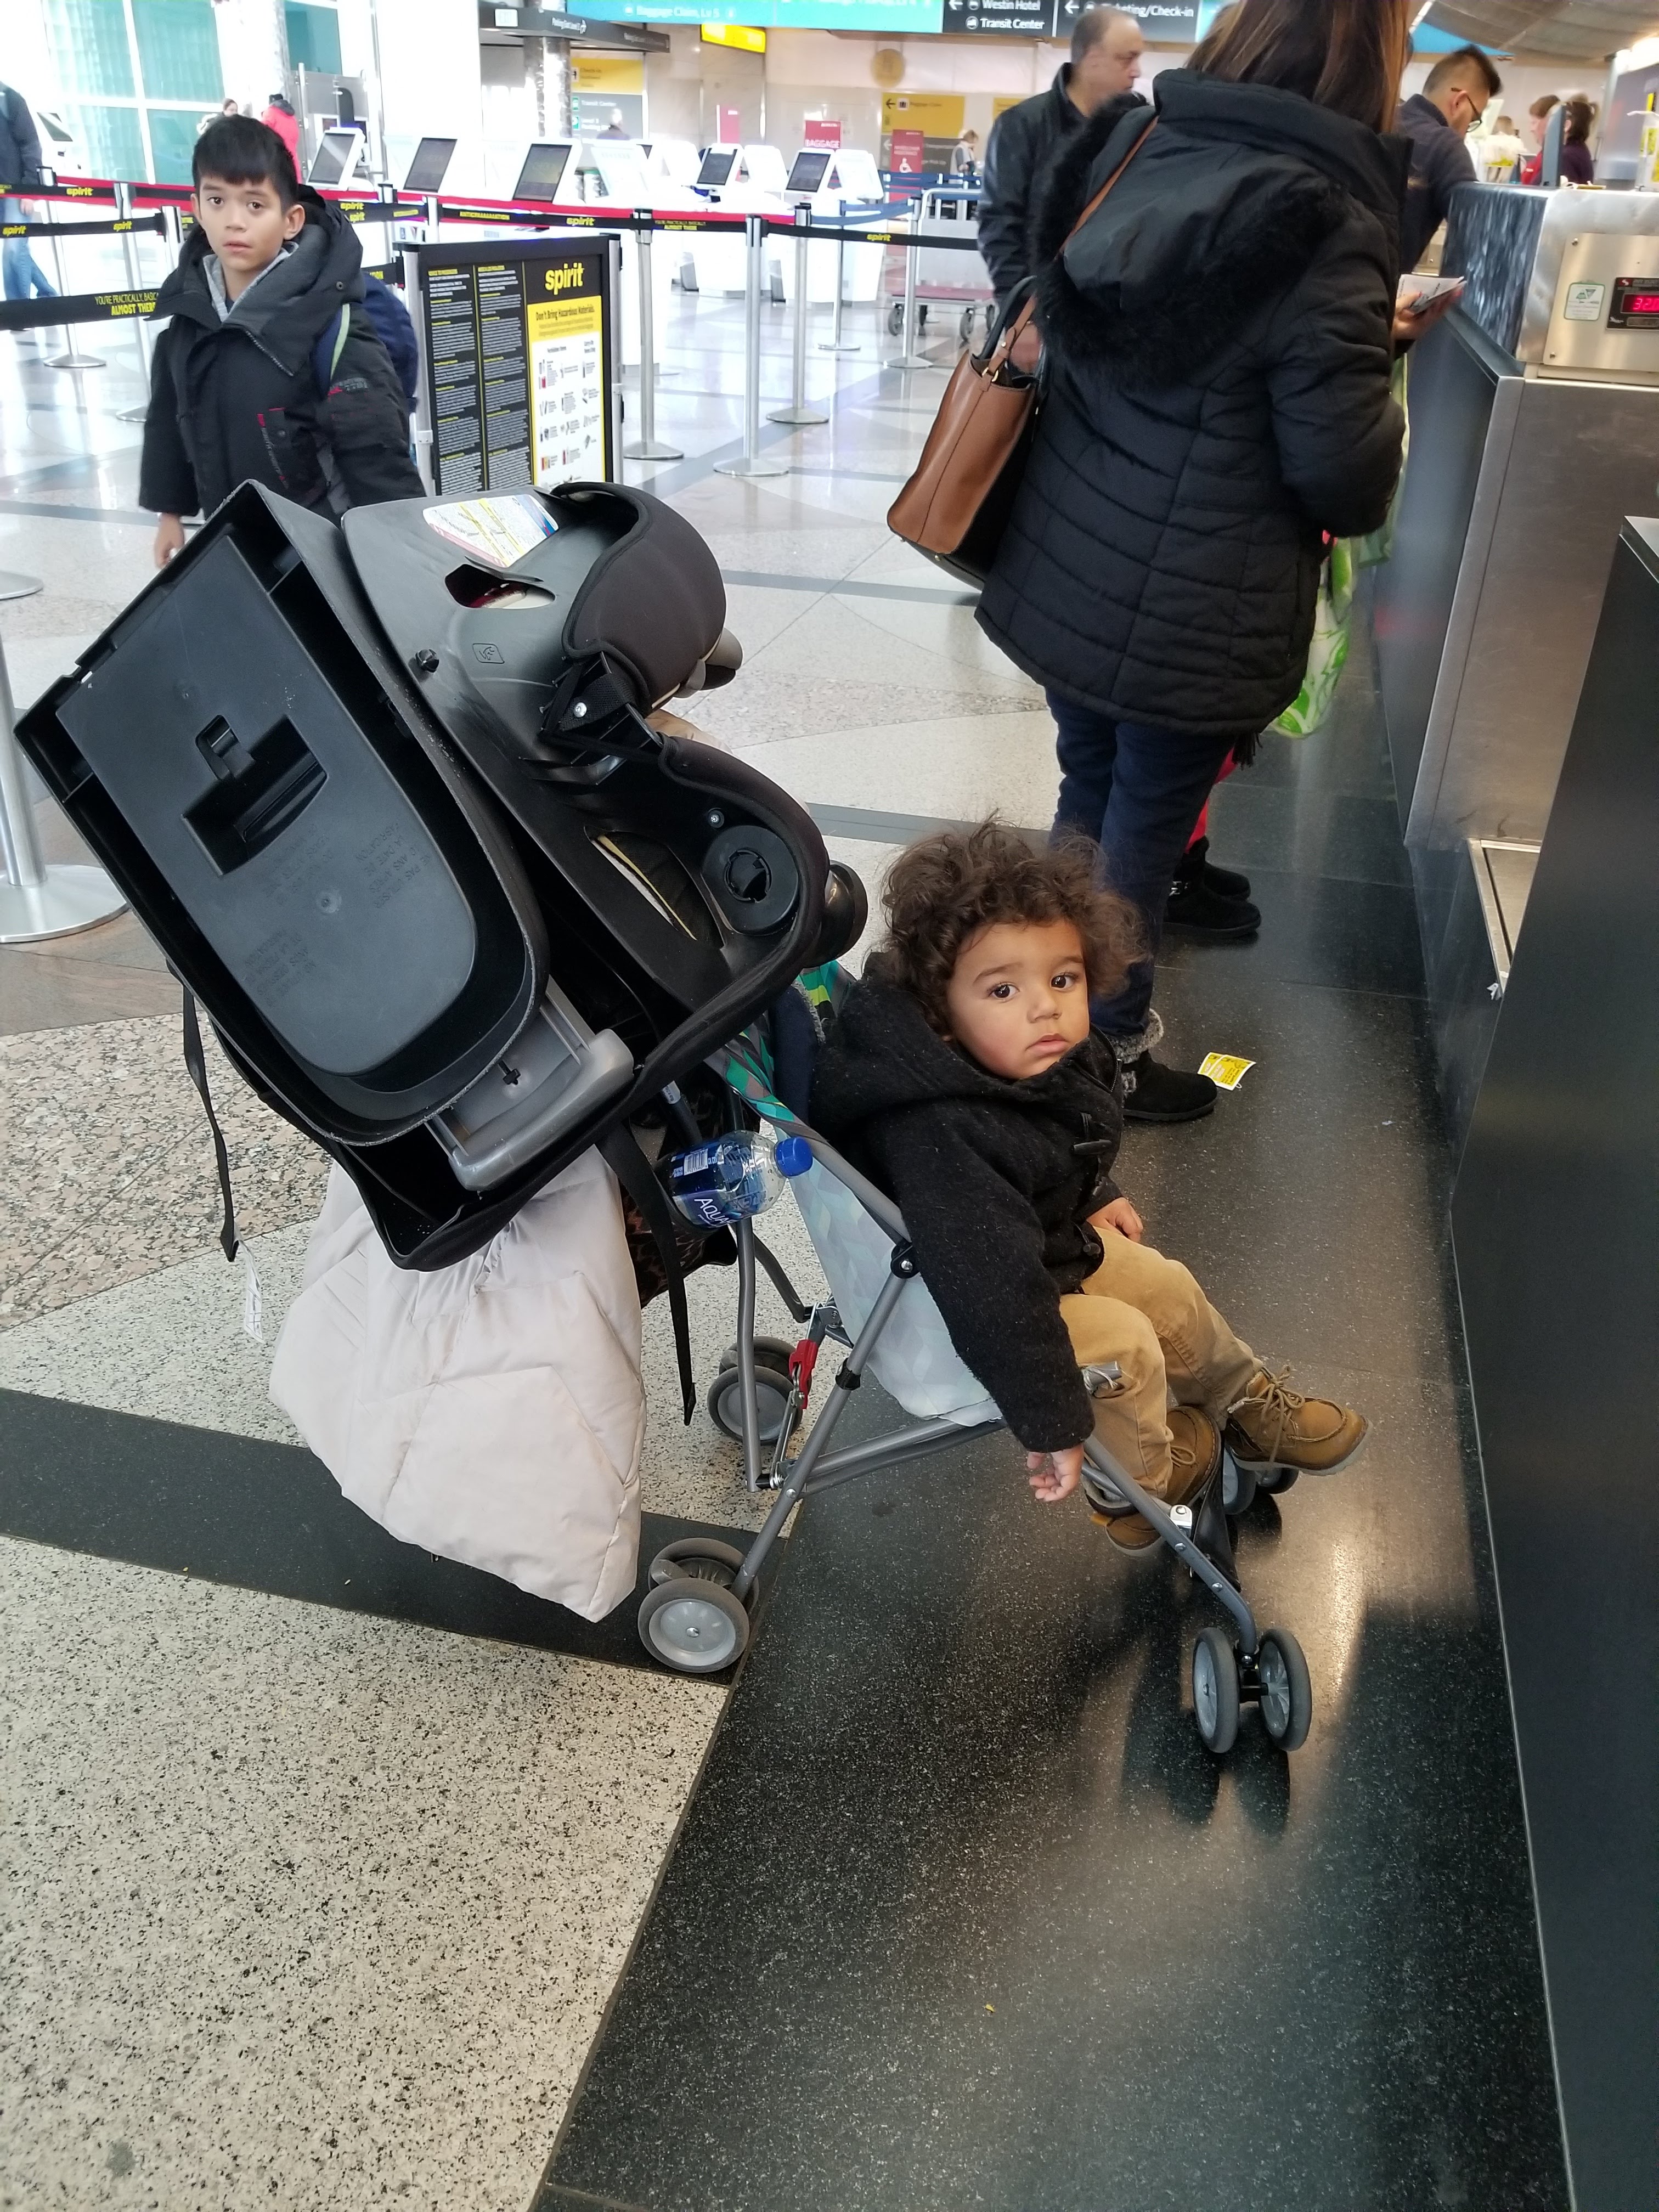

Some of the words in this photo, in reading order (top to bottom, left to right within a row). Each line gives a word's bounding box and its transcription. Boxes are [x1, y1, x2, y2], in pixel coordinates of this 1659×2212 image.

[982, 0, 1014, 9] Westin
[1015, 0, 1041, 10] Hotel
[1101, 3, 1194, 18] eting/Check-in
[980, 18, 1012, 29] Transit
[1013, 19, 1045, 30] Center
[805, 139, 840, 148] BAGGAGE
[66, 188, 93, 197] spirit
[113, 221, 133, 232] spirit
[566, 217, 595, 227] spirit
[3, 225, 27, 236] spirit
[867, 233, 891, 242] spirit
[545, 262, 585, 295] spirit
[94, 295, 112, 306] YOU'RE
[111, 304, 136, 316] ALMOST
